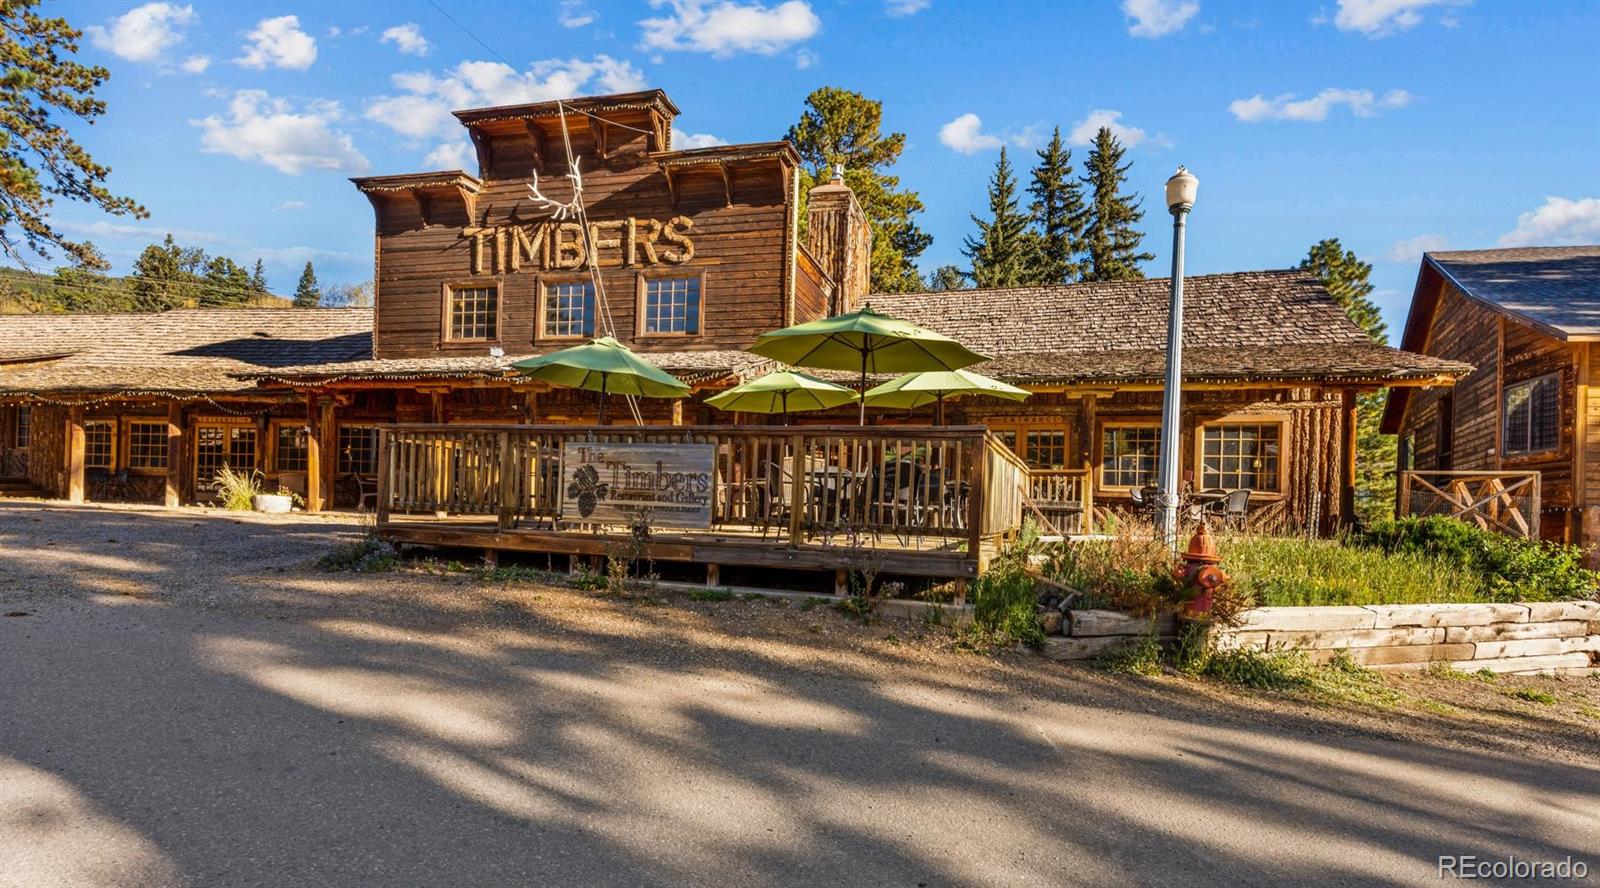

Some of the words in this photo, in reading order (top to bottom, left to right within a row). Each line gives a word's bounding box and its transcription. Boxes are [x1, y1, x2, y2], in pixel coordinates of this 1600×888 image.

[463, 215, 695, 274] TIMBERS
[577, 446, 605, 463] The
[606, 459, 709, 493] Timbers
[656, 490, 673, 502] and
[676, 490, 709, 506] Gallery
